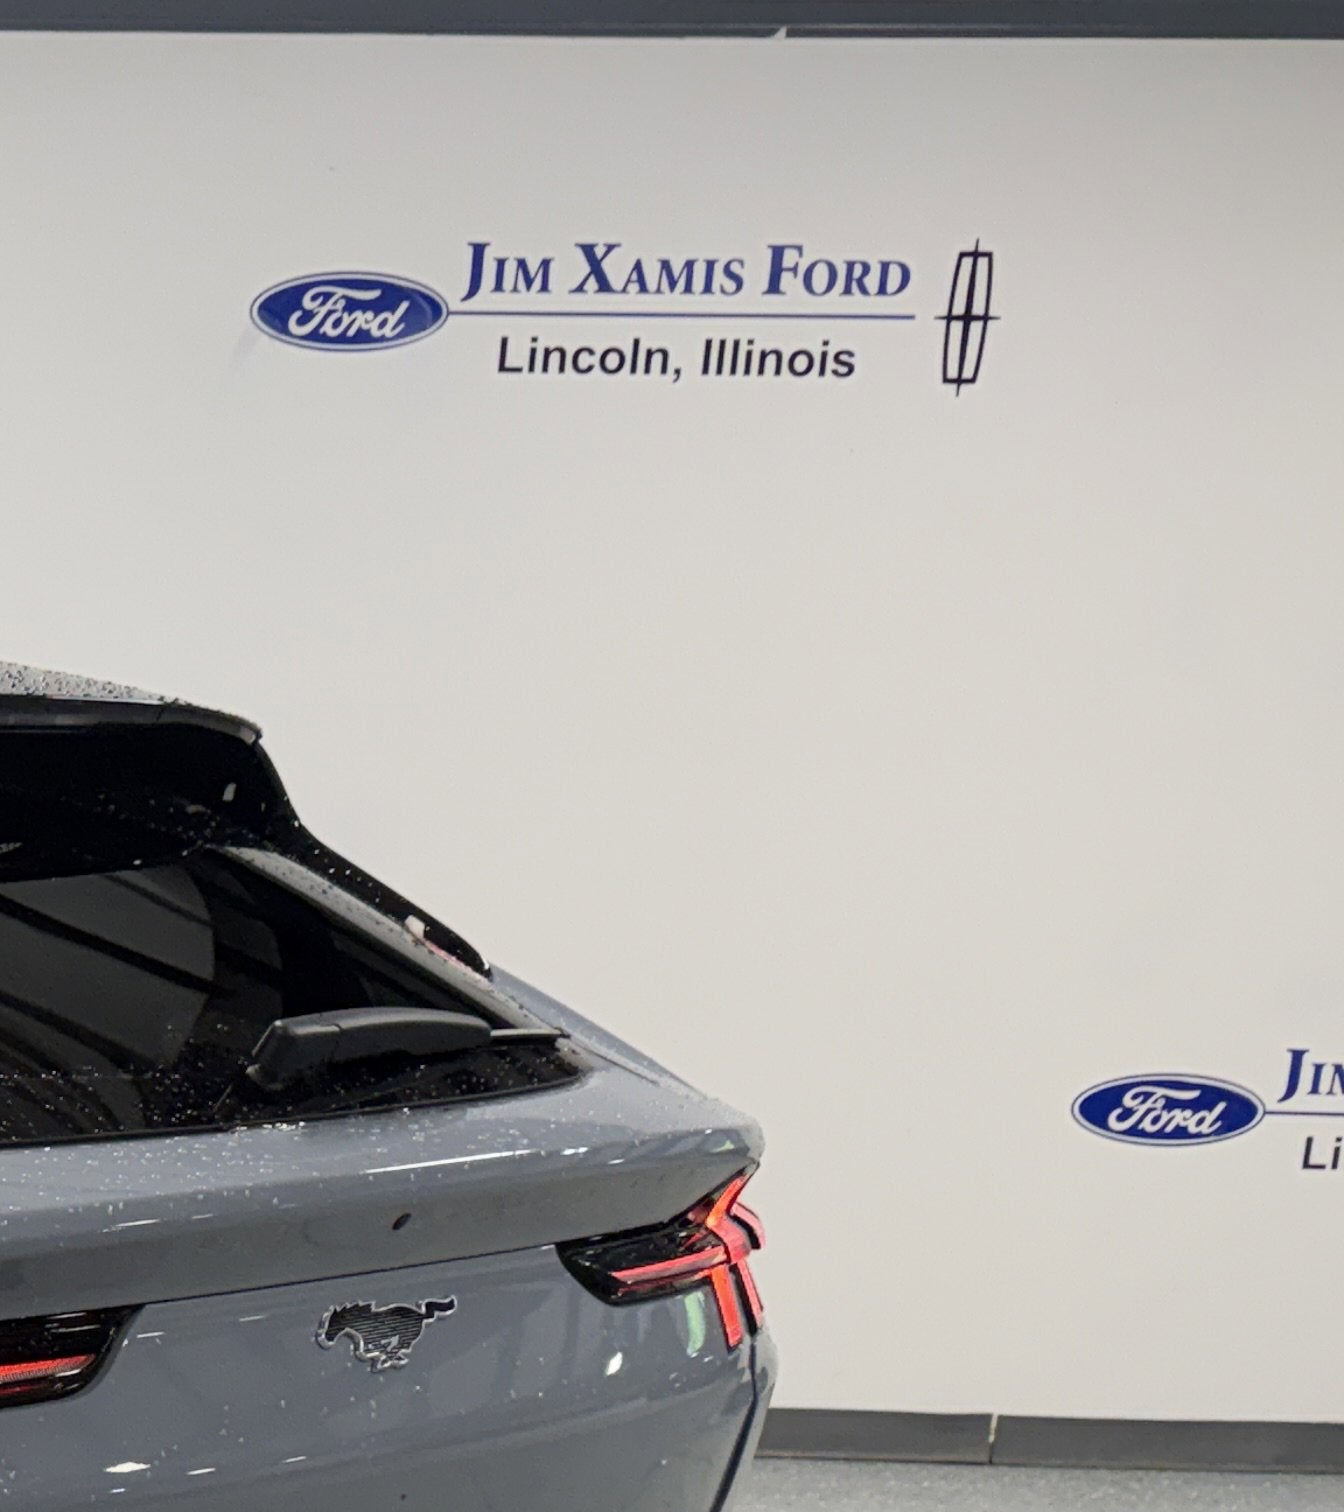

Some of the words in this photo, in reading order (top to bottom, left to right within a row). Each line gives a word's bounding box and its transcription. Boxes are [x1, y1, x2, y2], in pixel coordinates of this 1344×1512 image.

[459, 241, 556, 303] JIM
[568, 241, 745, 297] XAMIS
[761, 243, 912, 297] FORD
[287, 285, 412, 338] Ford
[497, 335, 683, 384] Lincoln,
[700, 338, 857, 379] Illinois
[1106, 1084, 1227, 1136] Ford
